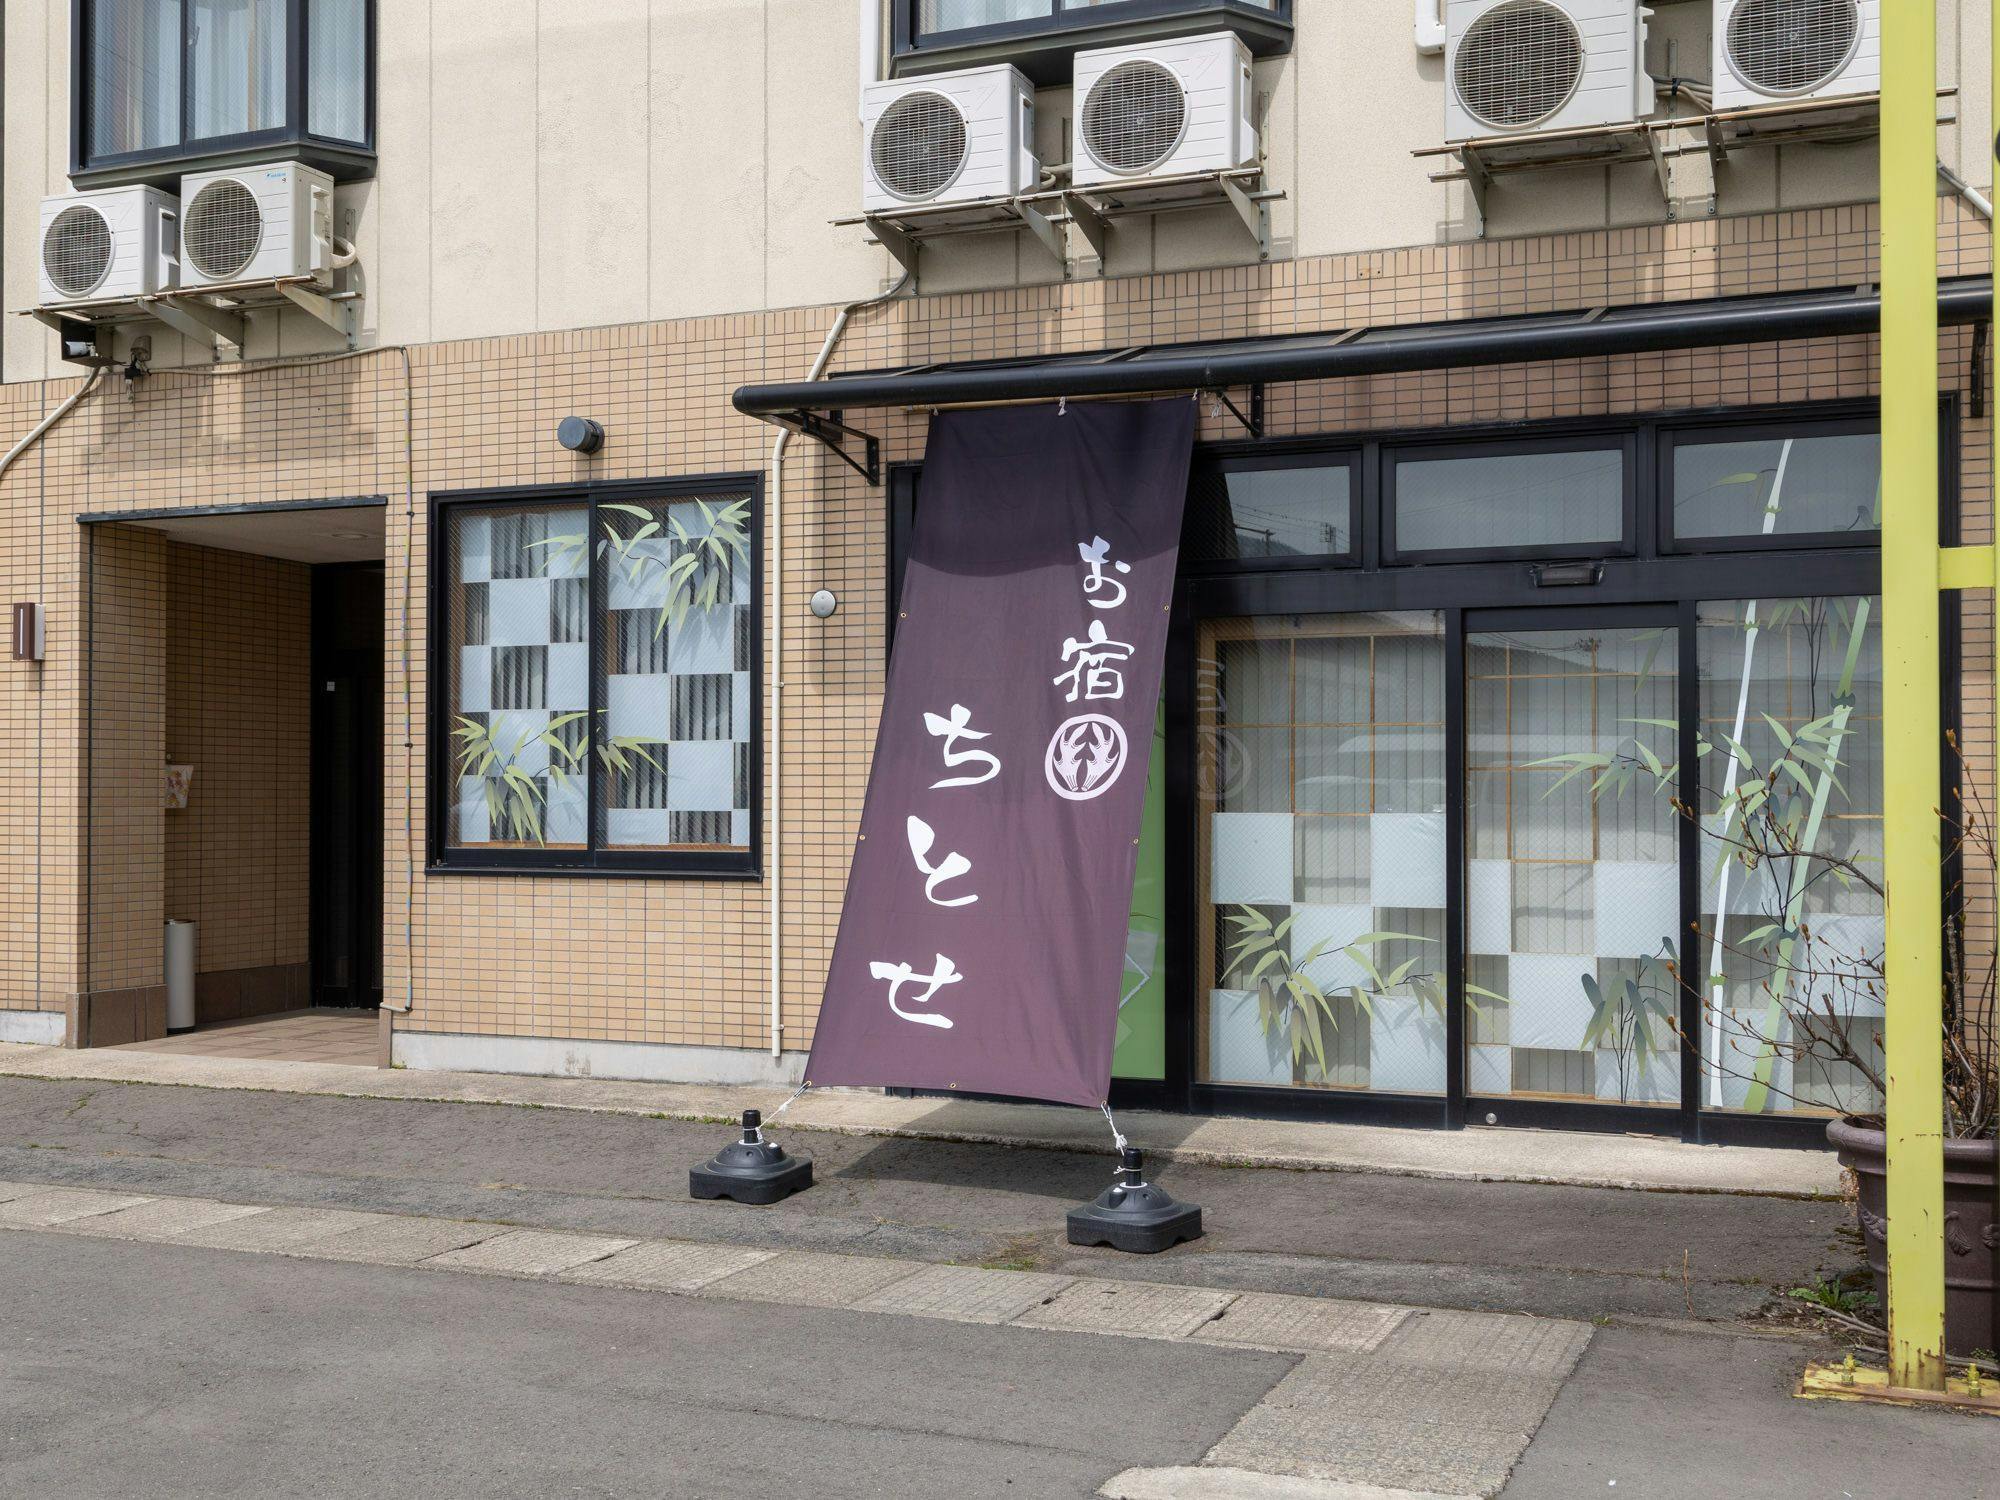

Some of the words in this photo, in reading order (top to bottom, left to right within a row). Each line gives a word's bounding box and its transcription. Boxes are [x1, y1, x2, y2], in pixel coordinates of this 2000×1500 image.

[1053, 535, 1135, 703] お宿
[869, 703, 1002, 1029] ちとせ
